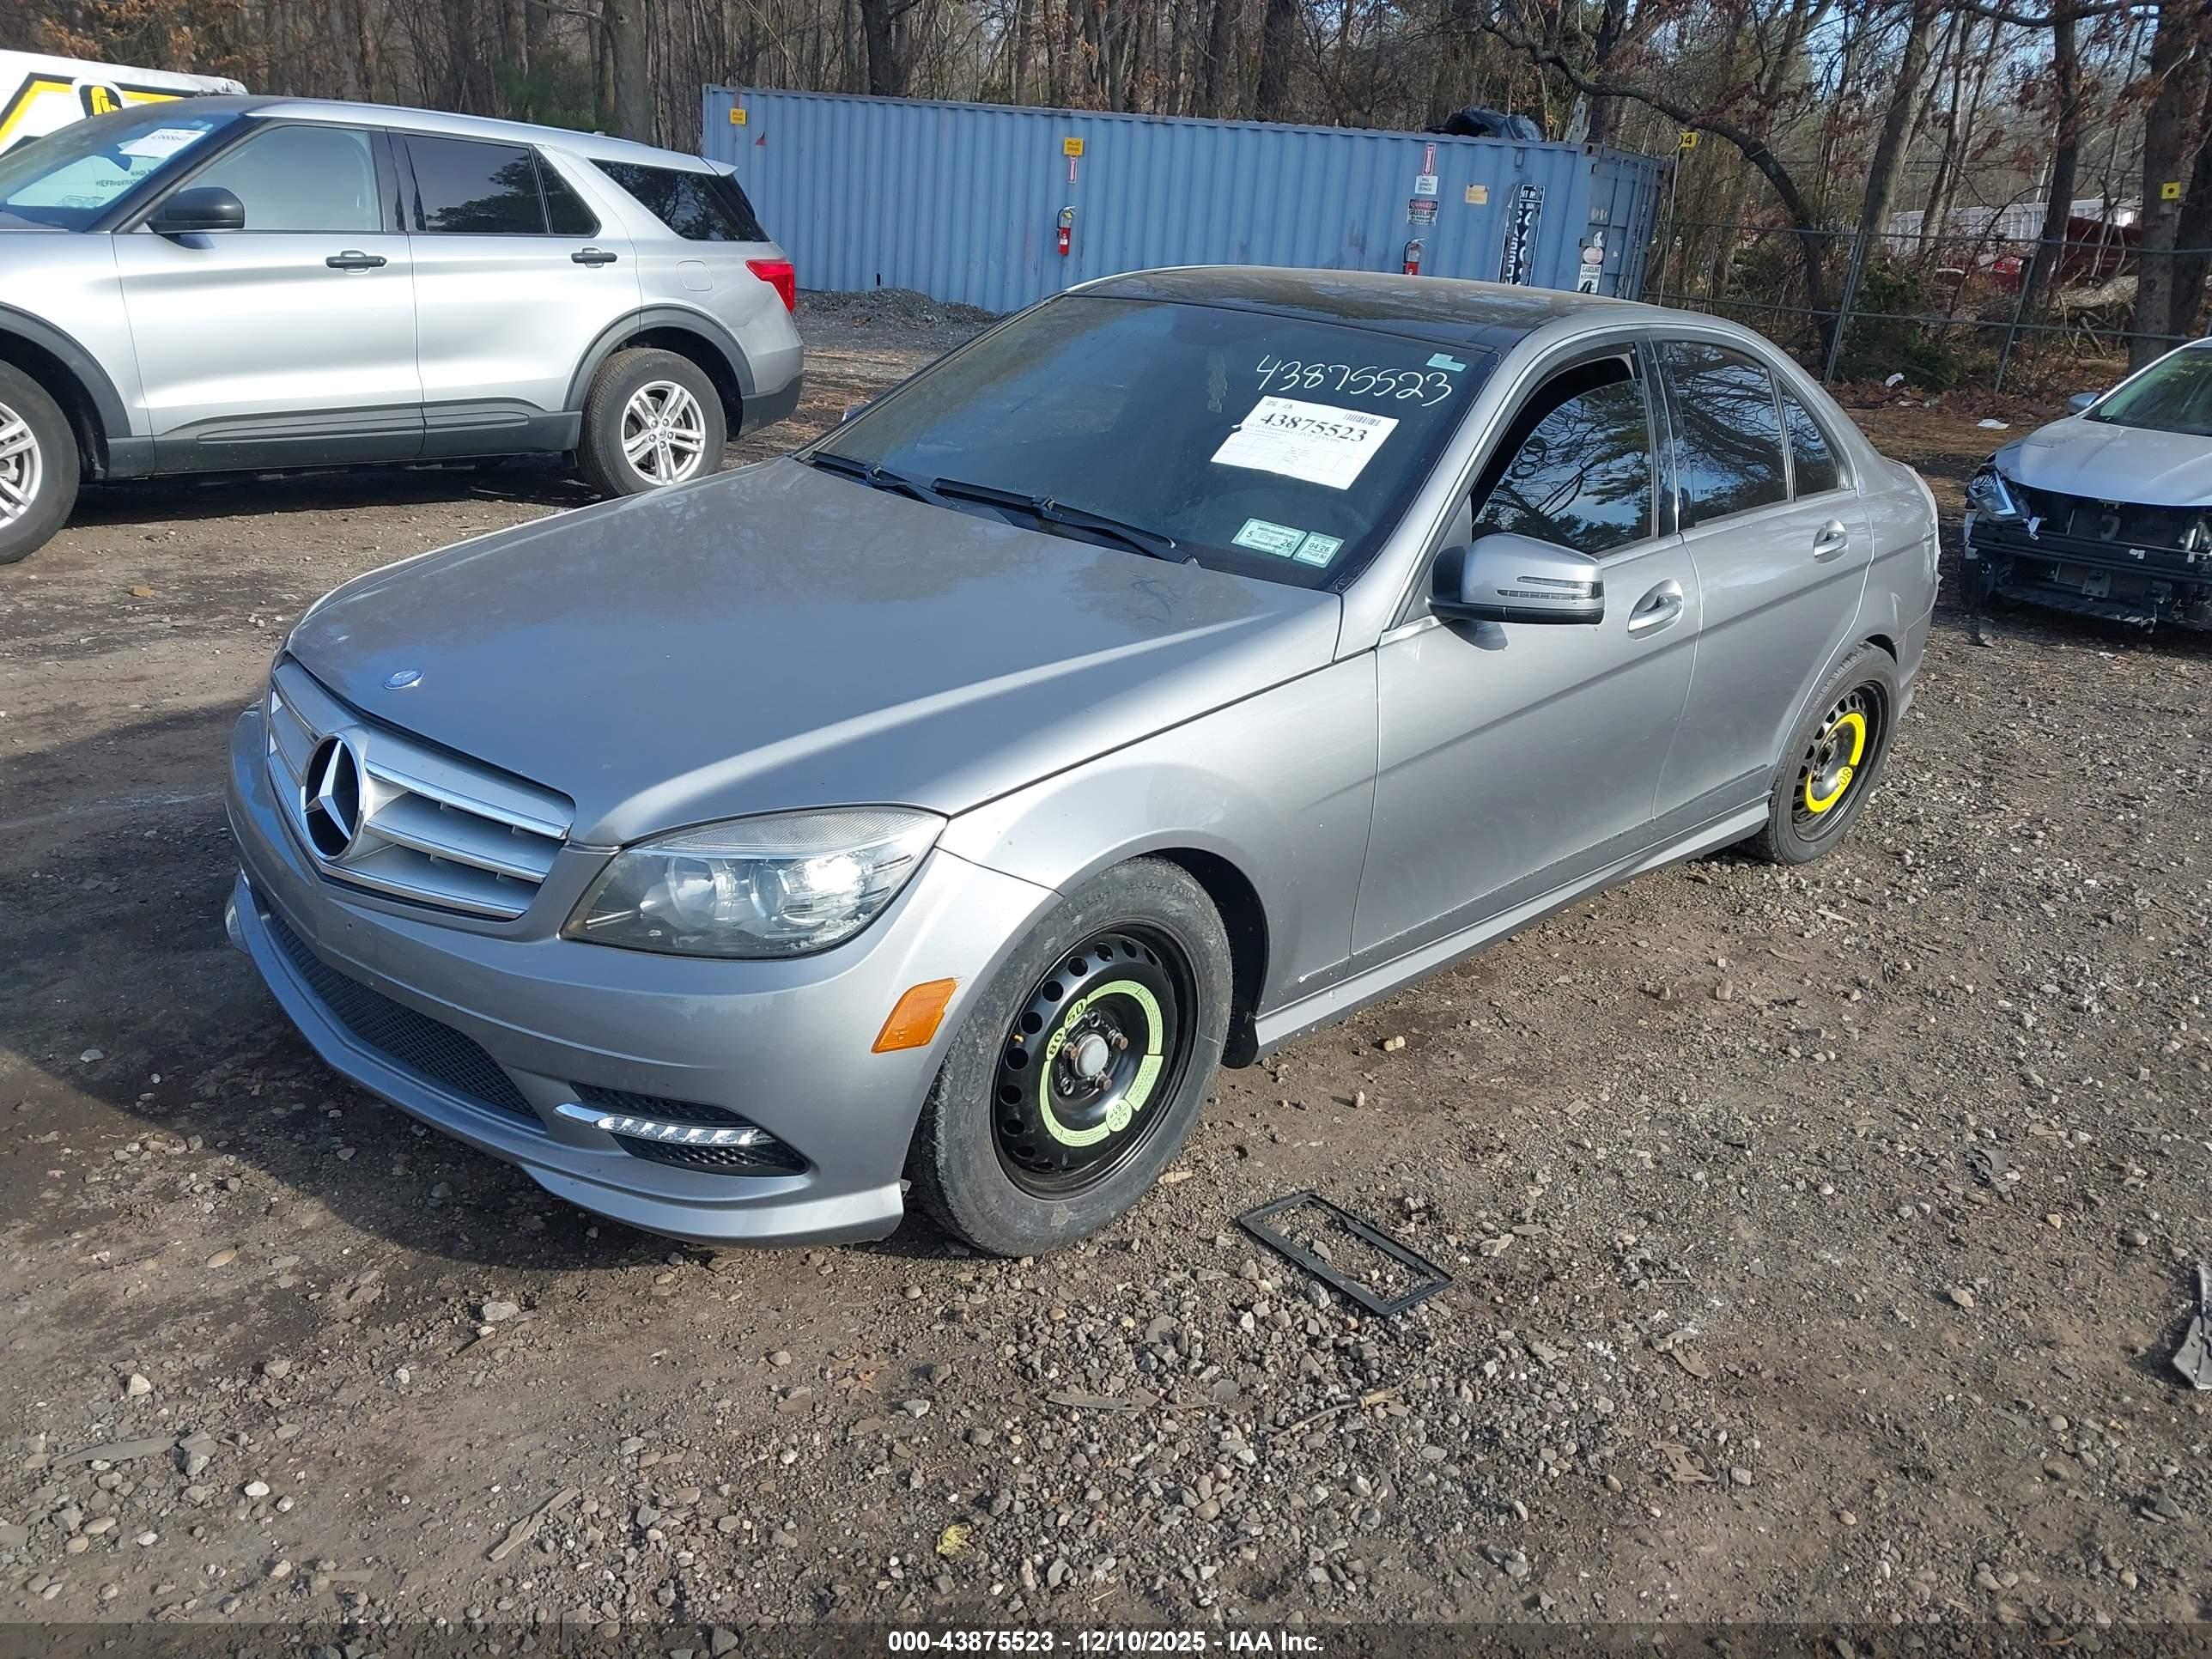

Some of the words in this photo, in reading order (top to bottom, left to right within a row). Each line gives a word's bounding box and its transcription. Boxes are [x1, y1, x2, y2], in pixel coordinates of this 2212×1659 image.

[1256, 354, 1453, 407] 43875523
[1260, 412, 1368, 442] 43875523
[1280, 538, 1295, 549] 26
[1308, 542, 1320, 550] 04
[1066, 1001, 1084, 1025] 50
[1048, 1032, 1063, 1055] 80
